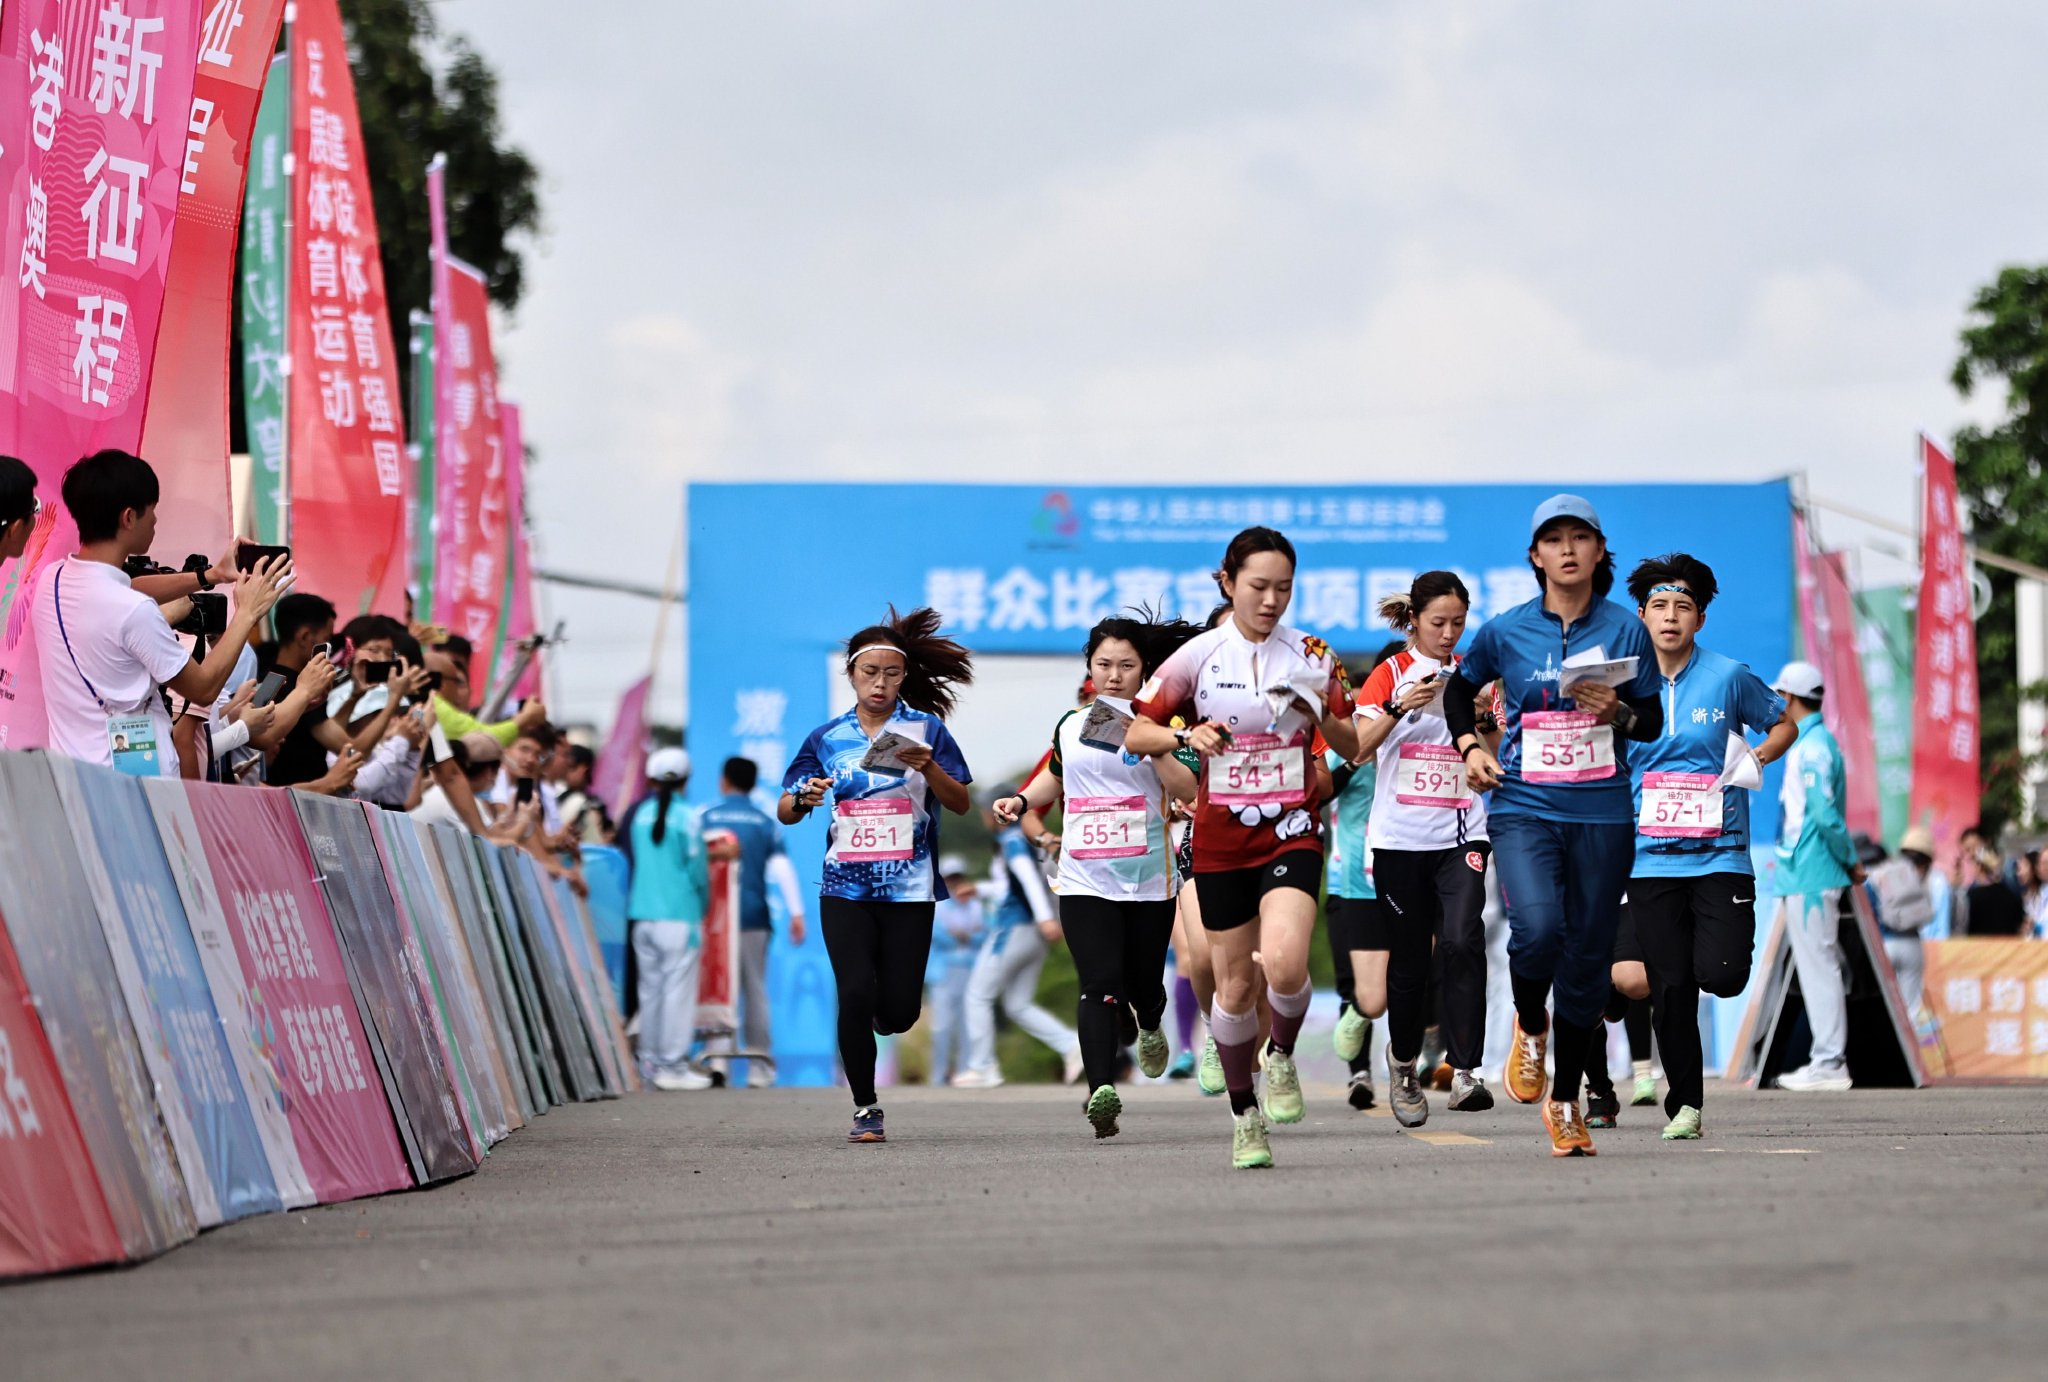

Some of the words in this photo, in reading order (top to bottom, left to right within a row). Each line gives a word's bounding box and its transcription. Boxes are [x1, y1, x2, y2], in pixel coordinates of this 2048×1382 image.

[73, 2, 164, 408] 新征程
[922, 566, 1545, 632] 群众比赛定项目赛
[1216, 682, 1246, 690] TRIMTEX
[1691, 707, 1726, 725] 浙江
[1542, 740, 1596, 766] 53-1
[1228, 762, 1285, 789] 54-1
[1427, 762, 1451, 771] 接力赛
[1414, 772, 1458, 794] 59-1
[1667, 791, 1692, 801] 接力赛
[860, 818, 885, 827] 接力赛
[1655, 801, 1703, 823] 57-1
[851, 827, 896, 848] 65-1
[1083, 822, 1129, 845] 55-1
